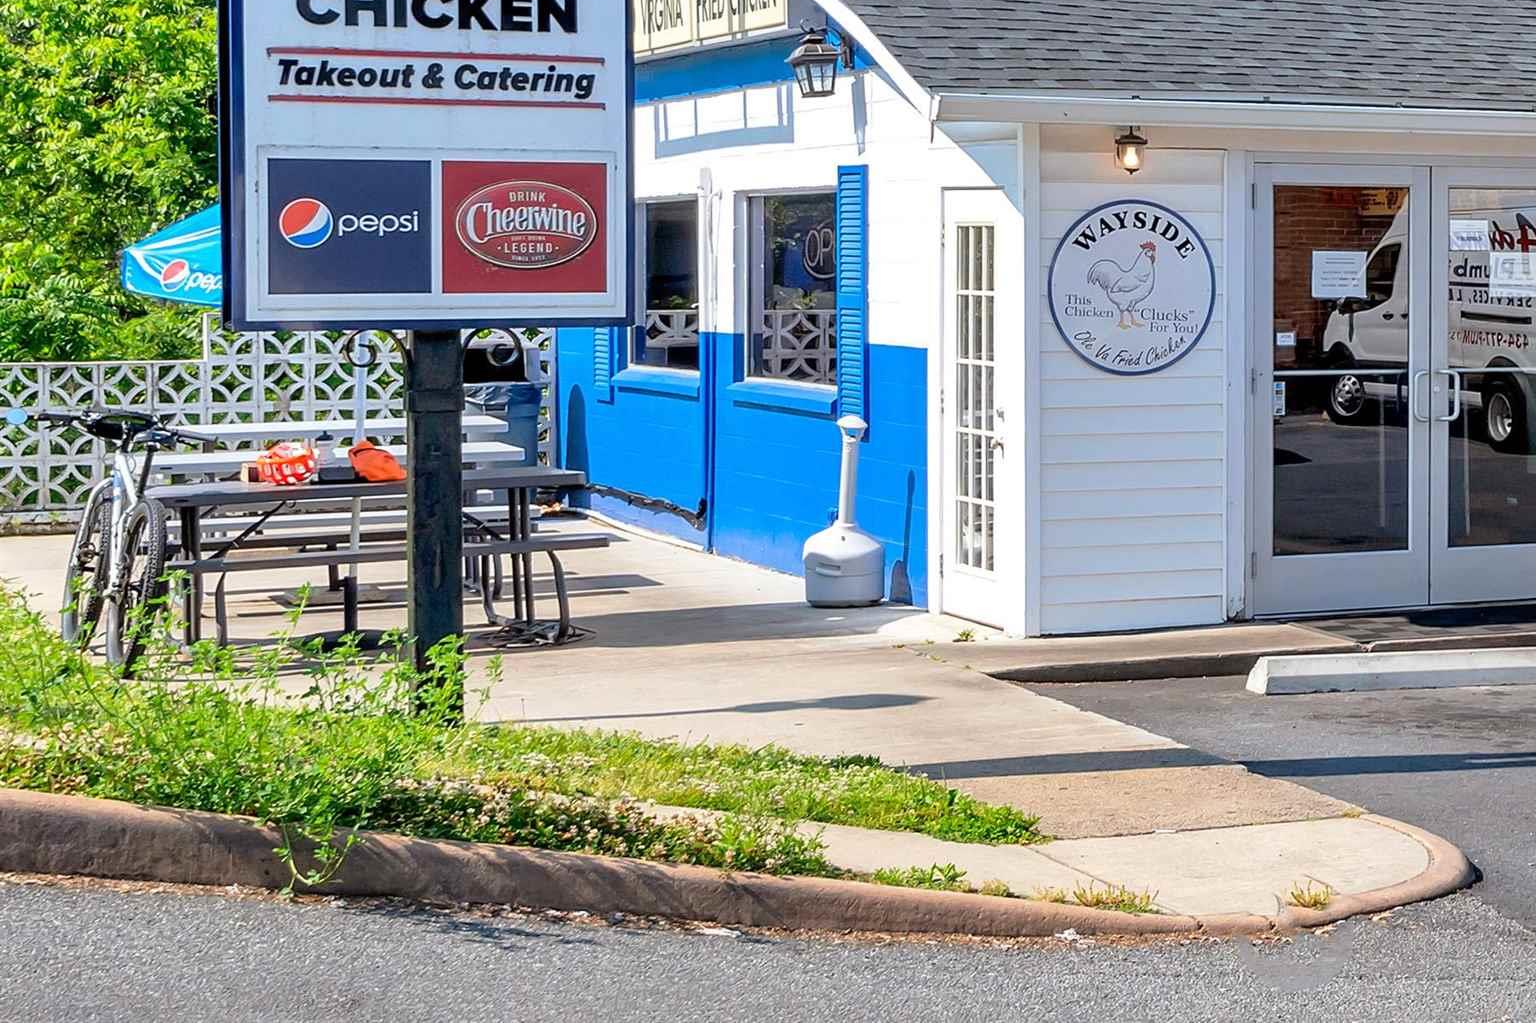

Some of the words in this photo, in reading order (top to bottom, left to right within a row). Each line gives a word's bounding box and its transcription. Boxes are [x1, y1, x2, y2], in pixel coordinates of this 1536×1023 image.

[277, 59, 415, 89] Takeout
[421, 62, 443, 90] &
[454, 64, 596, 100] Catering
[508, 191, 547, 203] DRINK
[338, 210, 419, 238] pepsi
[466, 202, 587, 244] Cheerwine
[1072, 210, 1196, 260] WAYSIDE
[504, 241, 553, 254] LEGEND
[1065, 293, 1092, 306] This
[1065, 306, 1114, 319] Chicken
[1150, 322, 1170, 333] For
[1173, 322, 1199, 334] You!
[1096, 344, 1112, 361] Va
[1112, 349, 1144, 367] Fried
[1145, 336, 1187, 366] Chicken
